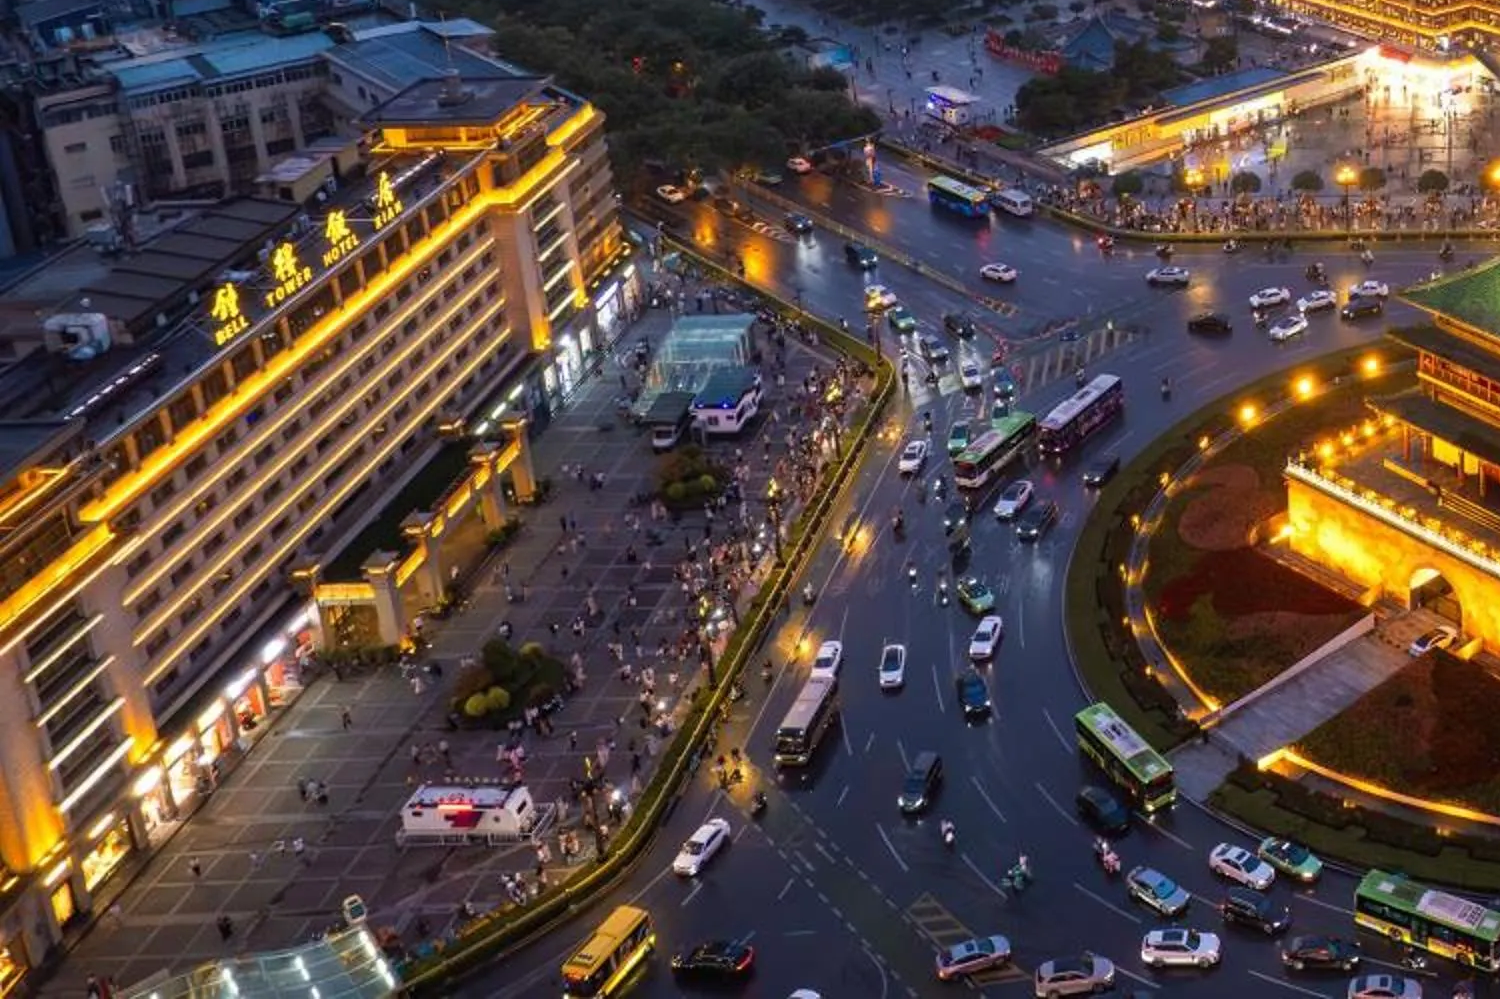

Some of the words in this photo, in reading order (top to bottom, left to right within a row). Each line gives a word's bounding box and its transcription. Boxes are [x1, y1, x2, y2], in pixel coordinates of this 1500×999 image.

[214, 314, 250, 346] BELL
[265, 266, 312, 308] TOWER
[323, 233, 360, 268] HOTEL
